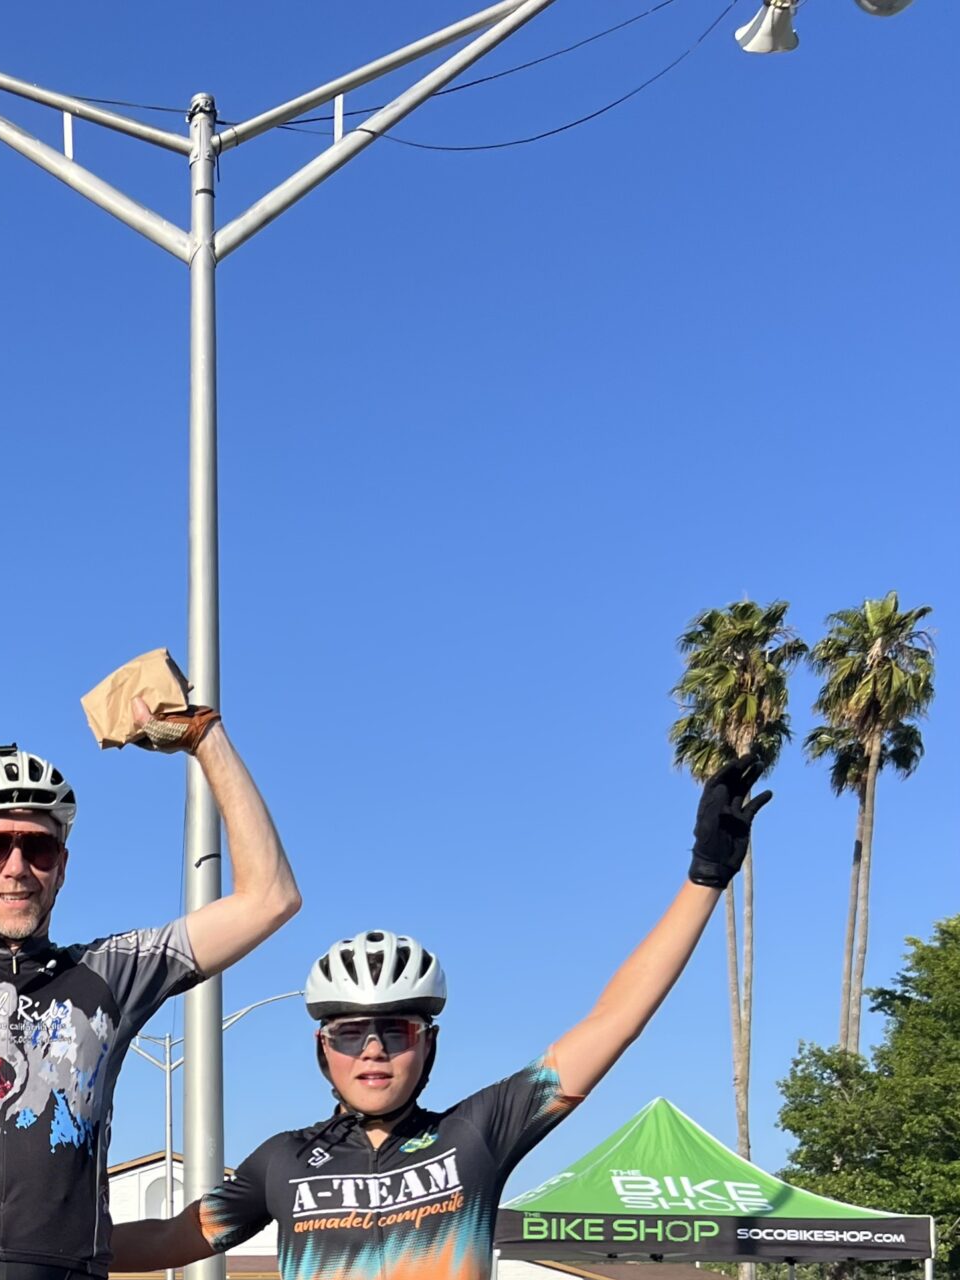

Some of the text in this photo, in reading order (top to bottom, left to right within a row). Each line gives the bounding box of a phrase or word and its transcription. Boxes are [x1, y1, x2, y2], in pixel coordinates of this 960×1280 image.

[17, 994, 68, 1022] Ride
[292, 1154, 461, 1212] A-TEAM
[611, 1176, 769, 1203] BIKE
[293, 1191, 465, 1233] annadel composite
[620, 1196, 774, 1213] SHOP
[523, 1217, 605, 1241] BIKE
[612, 1218, 720, 1243] SHOP
